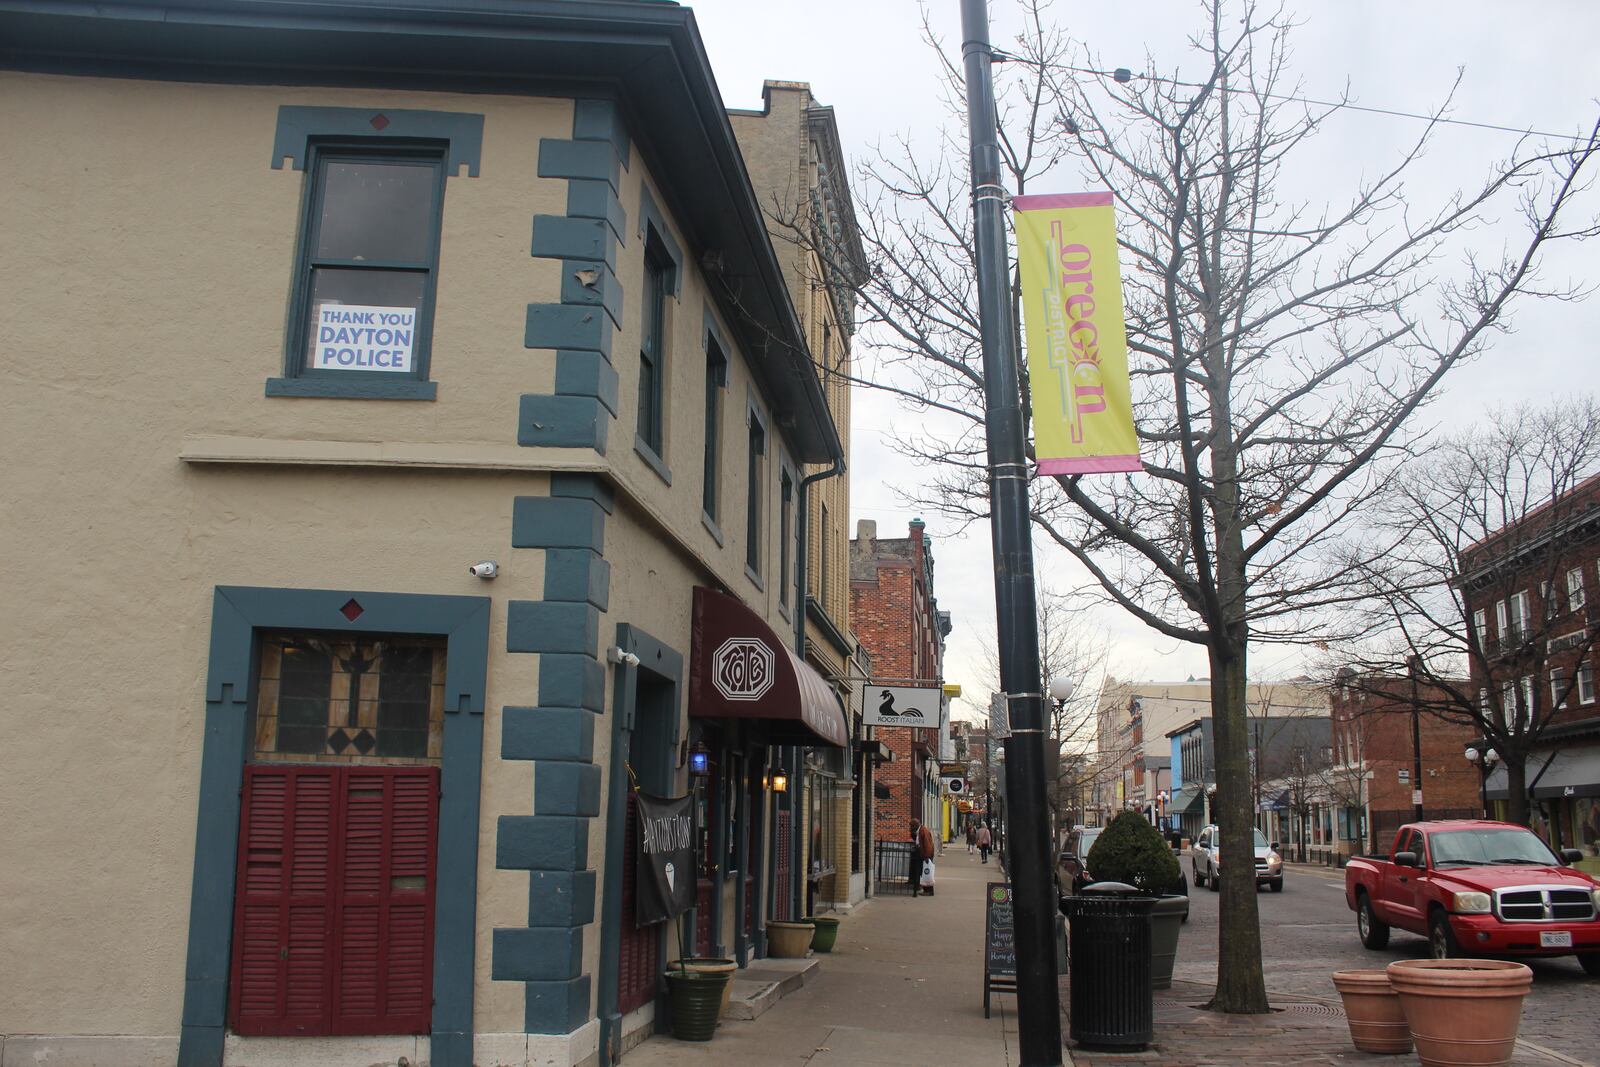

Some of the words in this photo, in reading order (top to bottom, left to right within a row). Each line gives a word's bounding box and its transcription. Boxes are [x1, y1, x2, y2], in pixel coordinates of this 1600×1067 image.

[322, 310, 375, 325] THANK
[379, 313, 413, 326] YOU
[319, 326, 411, 347] DAYTON
[1049, 295, 1068, 365] DISTRICT
[322, 347, 404, 367] POLICE
